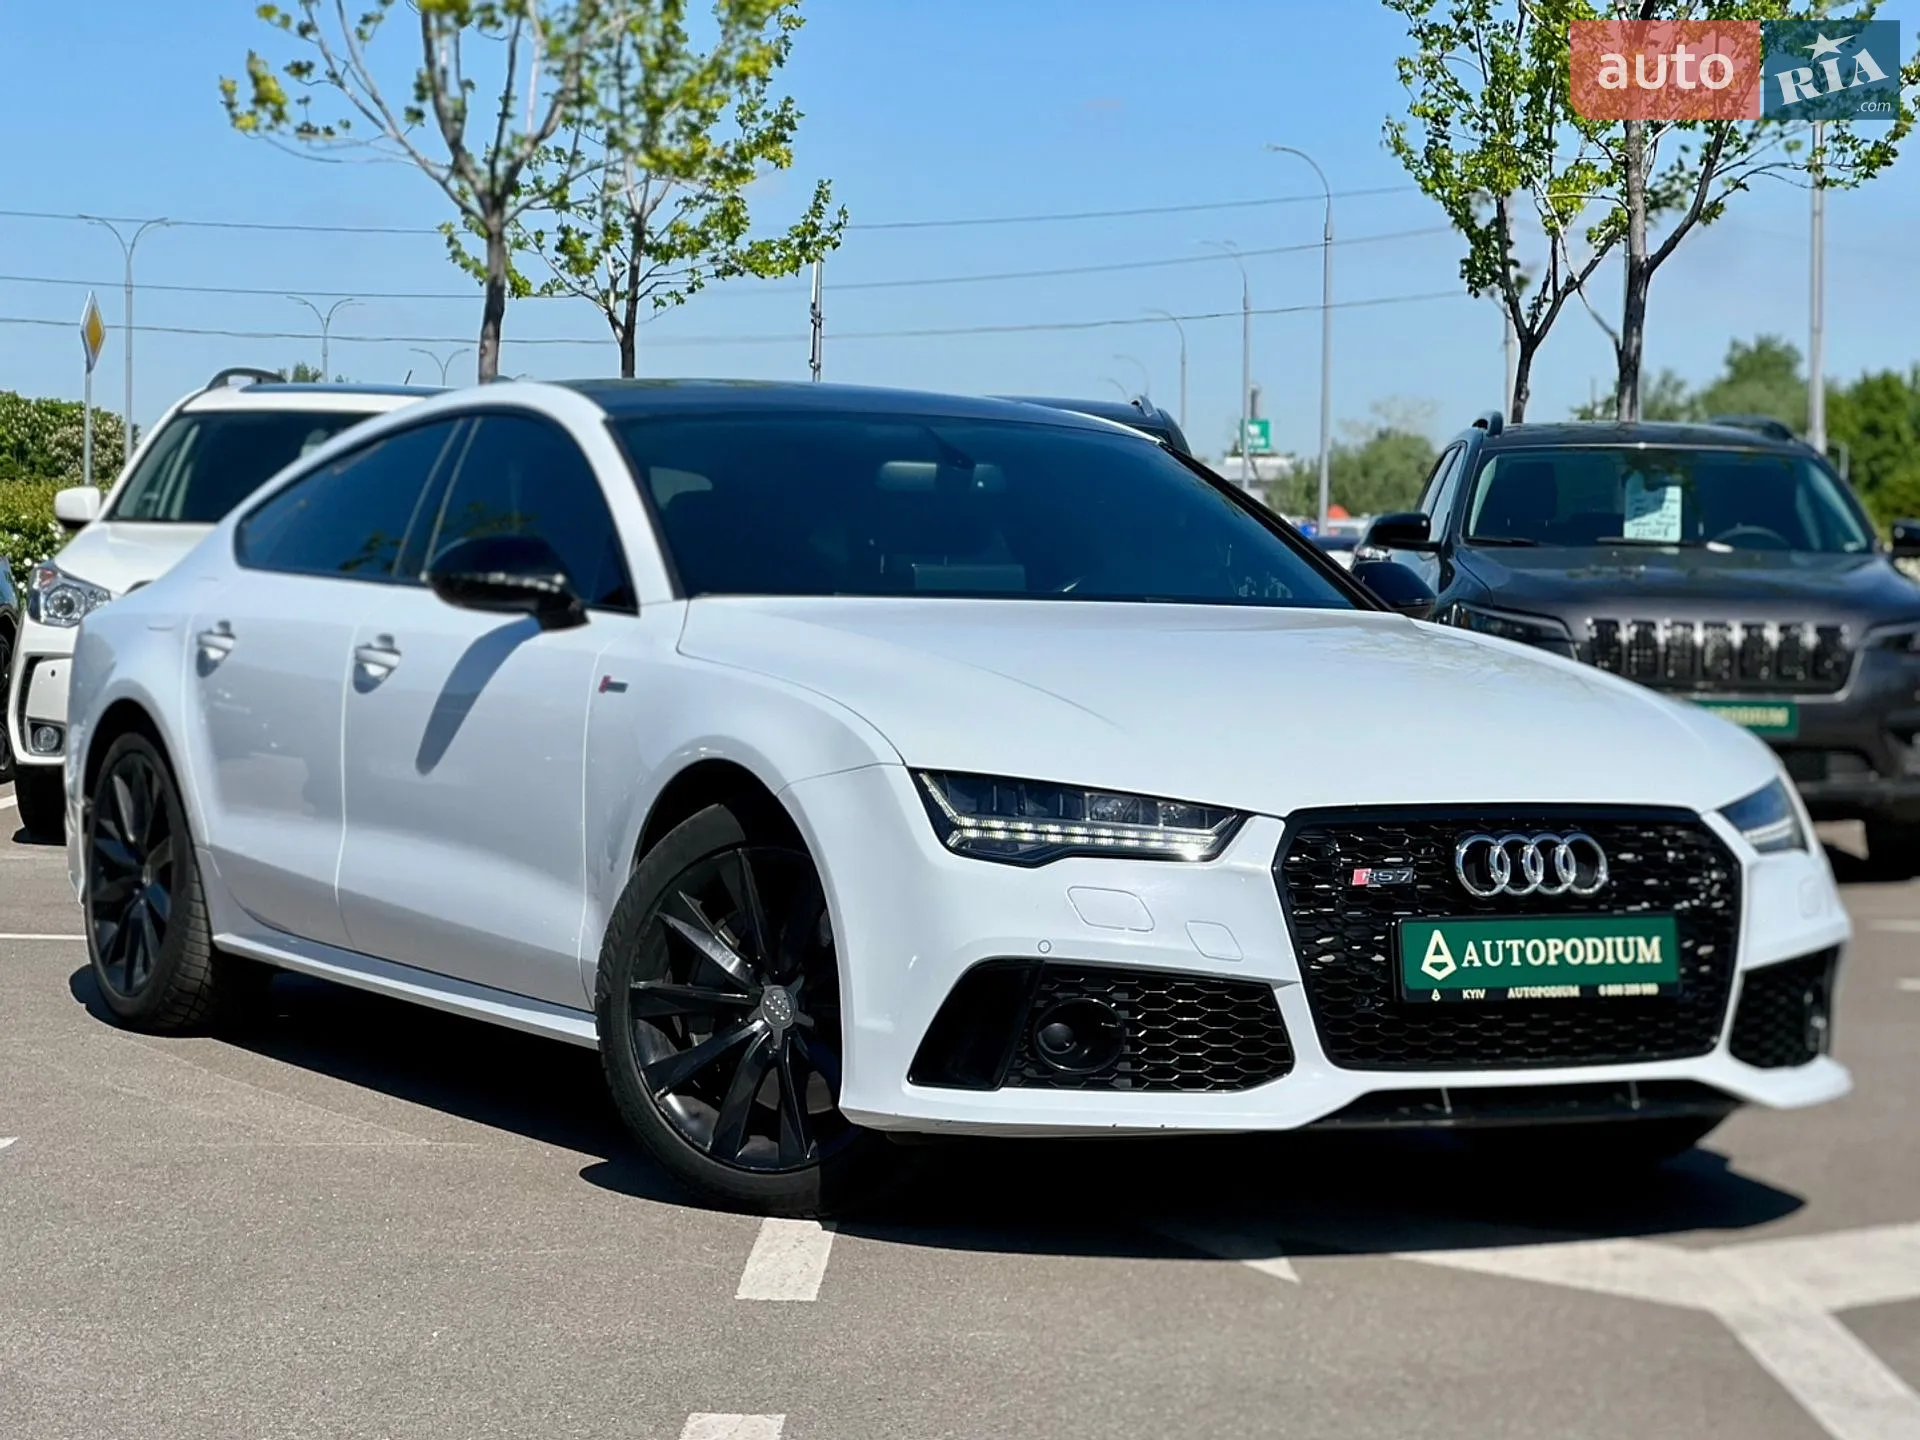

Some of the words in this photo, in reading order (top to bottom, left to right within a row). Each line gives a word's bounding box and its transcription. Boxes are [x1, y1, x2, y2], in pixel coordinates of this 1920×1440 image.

[1461, 935, 1663, 968] AUTOPODIUM
[1462, 988, 1486, 1000] KYIV
[1507, 985, 1580, 999] AUTOPODIUM
